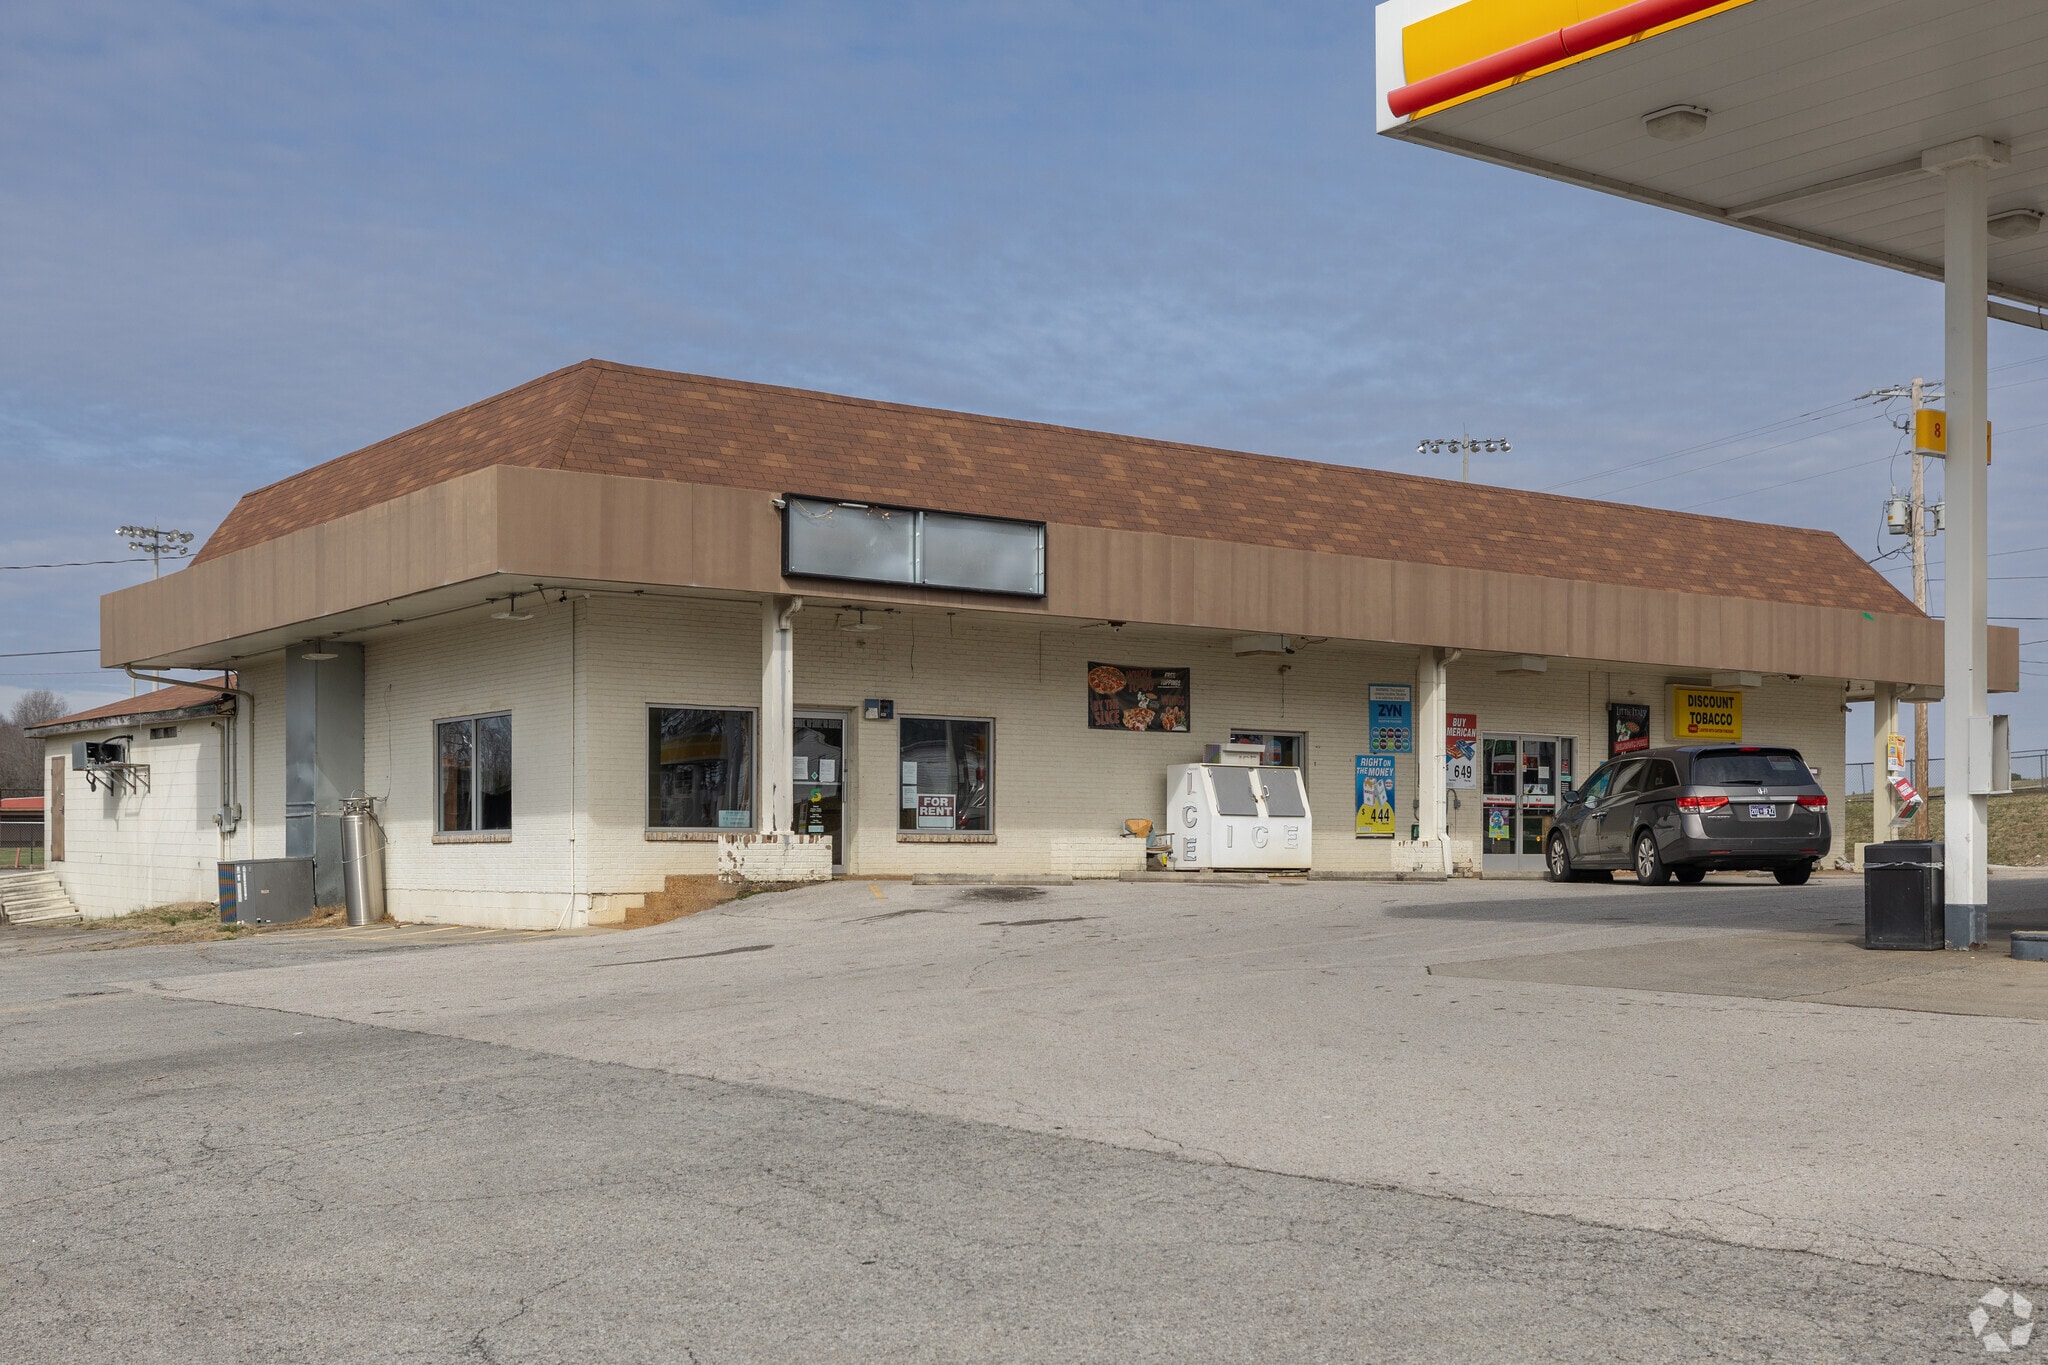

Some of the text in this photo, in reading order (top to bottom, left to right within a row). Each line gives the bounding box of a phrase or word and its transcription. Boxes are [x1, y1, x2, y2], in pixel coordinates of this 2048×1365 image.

[1934, 423, 1941, 438] 8
[1687, 694, 1734, 709] DISCOUNT
[1378, 704, 1402, 717] ZYN
[1093, 710, 1120, 726] SLICE
[1452, 717, 1467, 727] BUY
[1690, 711, 1733, 726] TOBACCO
[1446, 727, 1477, 738] MERICAN
[1361, 758, 1383, 766] RIGHT
[1368, 768, 1394, 776] MONEY
[924, 797, 949, 806] FOR
[920, 806, 952, 816] RENT
[1226, 824, 1299, 850] ICE
